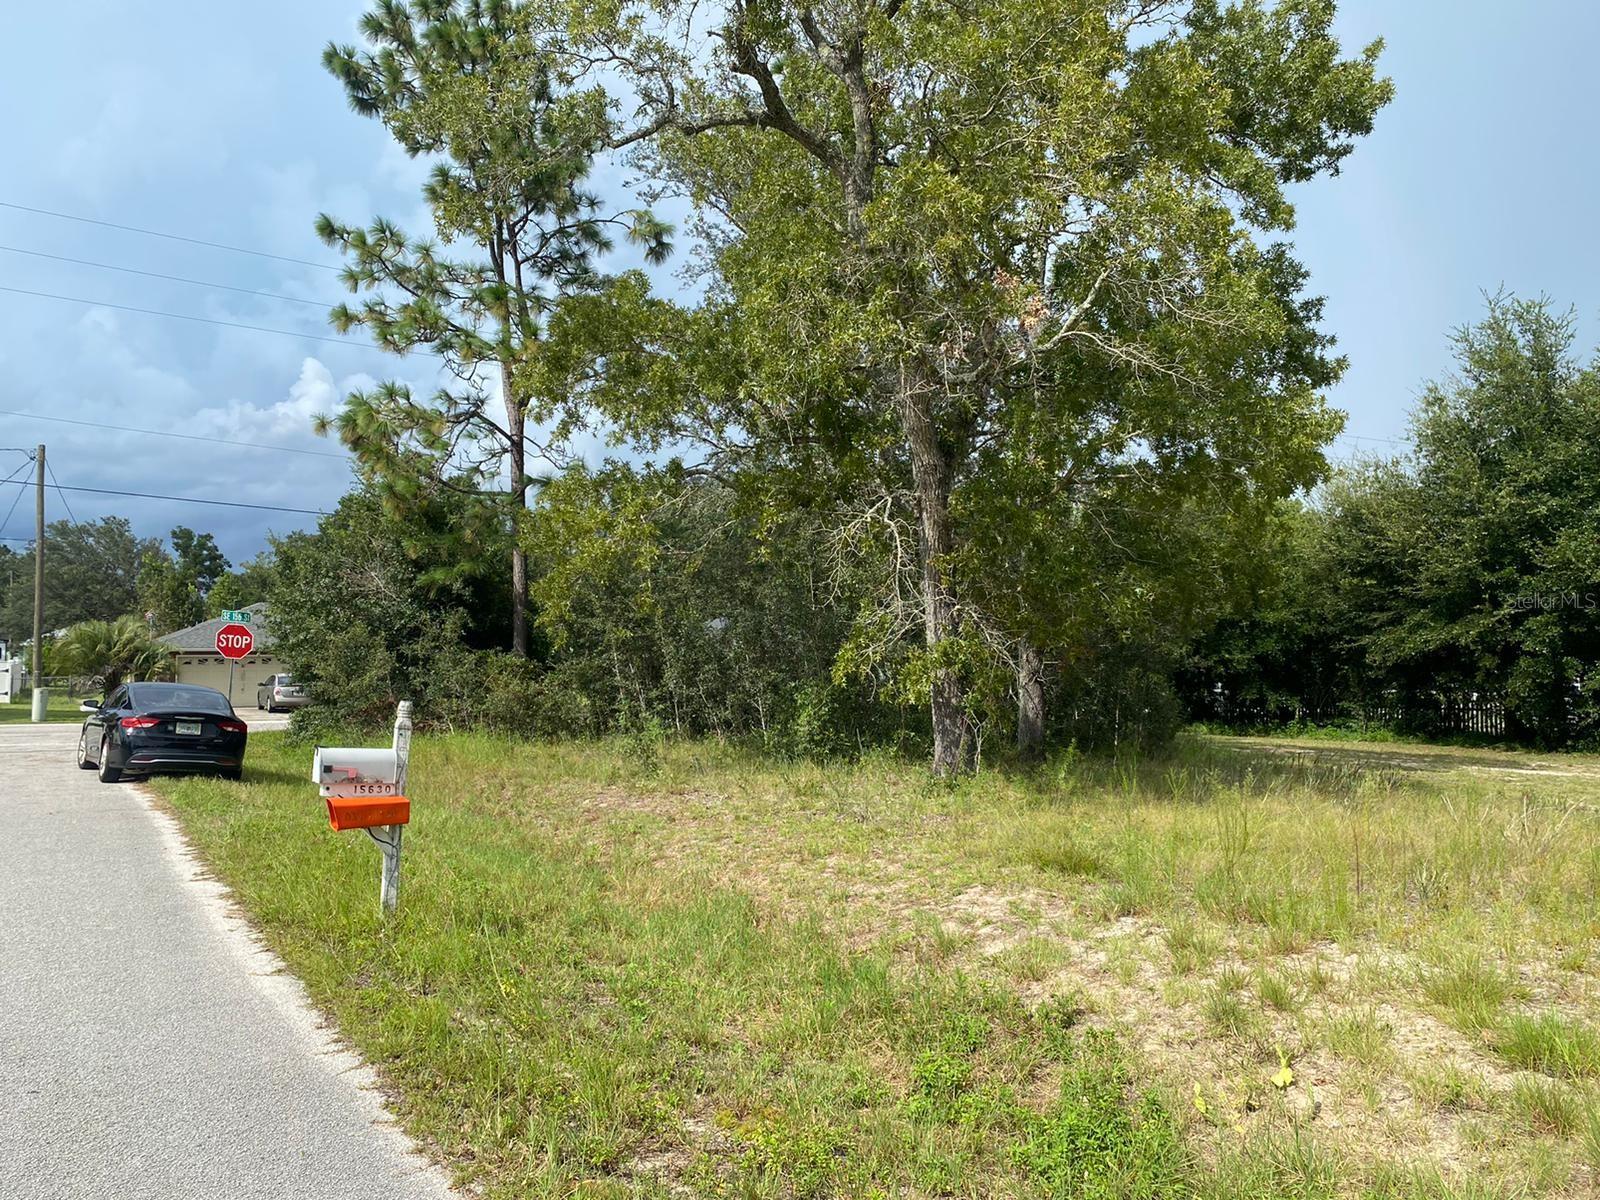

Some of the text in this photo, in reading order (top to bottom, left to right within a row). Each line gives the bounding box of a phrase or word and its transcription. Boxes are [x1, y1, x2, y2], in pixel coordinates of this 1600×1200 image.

[223, 611, 231, 621] SE
[218, 634, 250, 649] STOP
[354, 785, 391, 794] 15630
